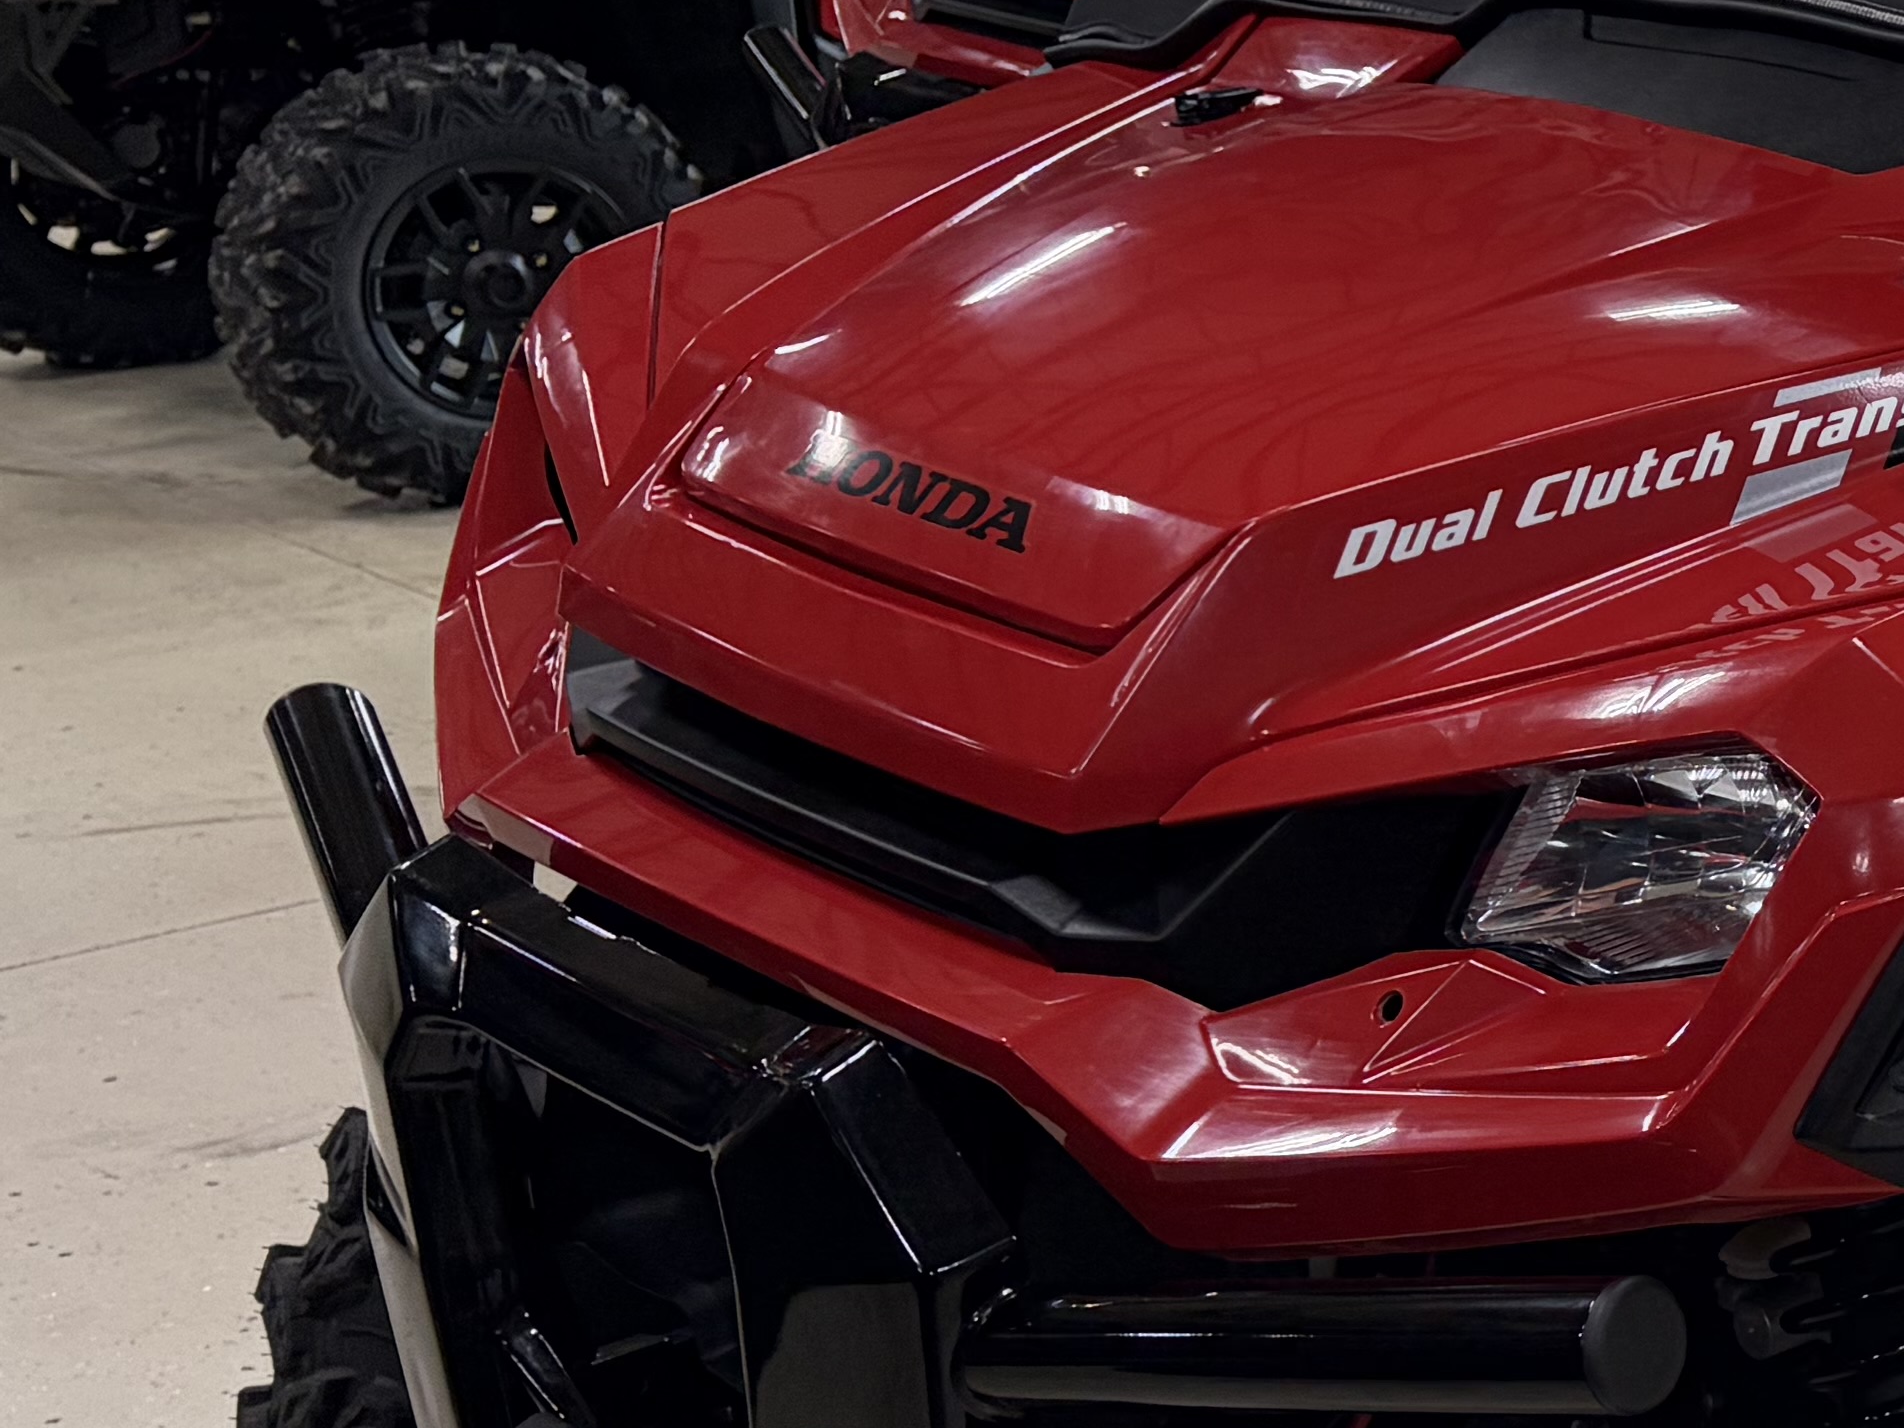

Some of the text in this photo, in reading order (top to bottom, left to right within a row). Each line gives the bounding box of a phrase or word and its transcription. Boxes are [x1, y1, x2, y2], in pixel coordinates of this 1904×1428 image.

[785, 430, 1039, 554] HONDA
[1333, 488, 1504, 580] Dual
[1515, 430, 1735, 529] Clutch
